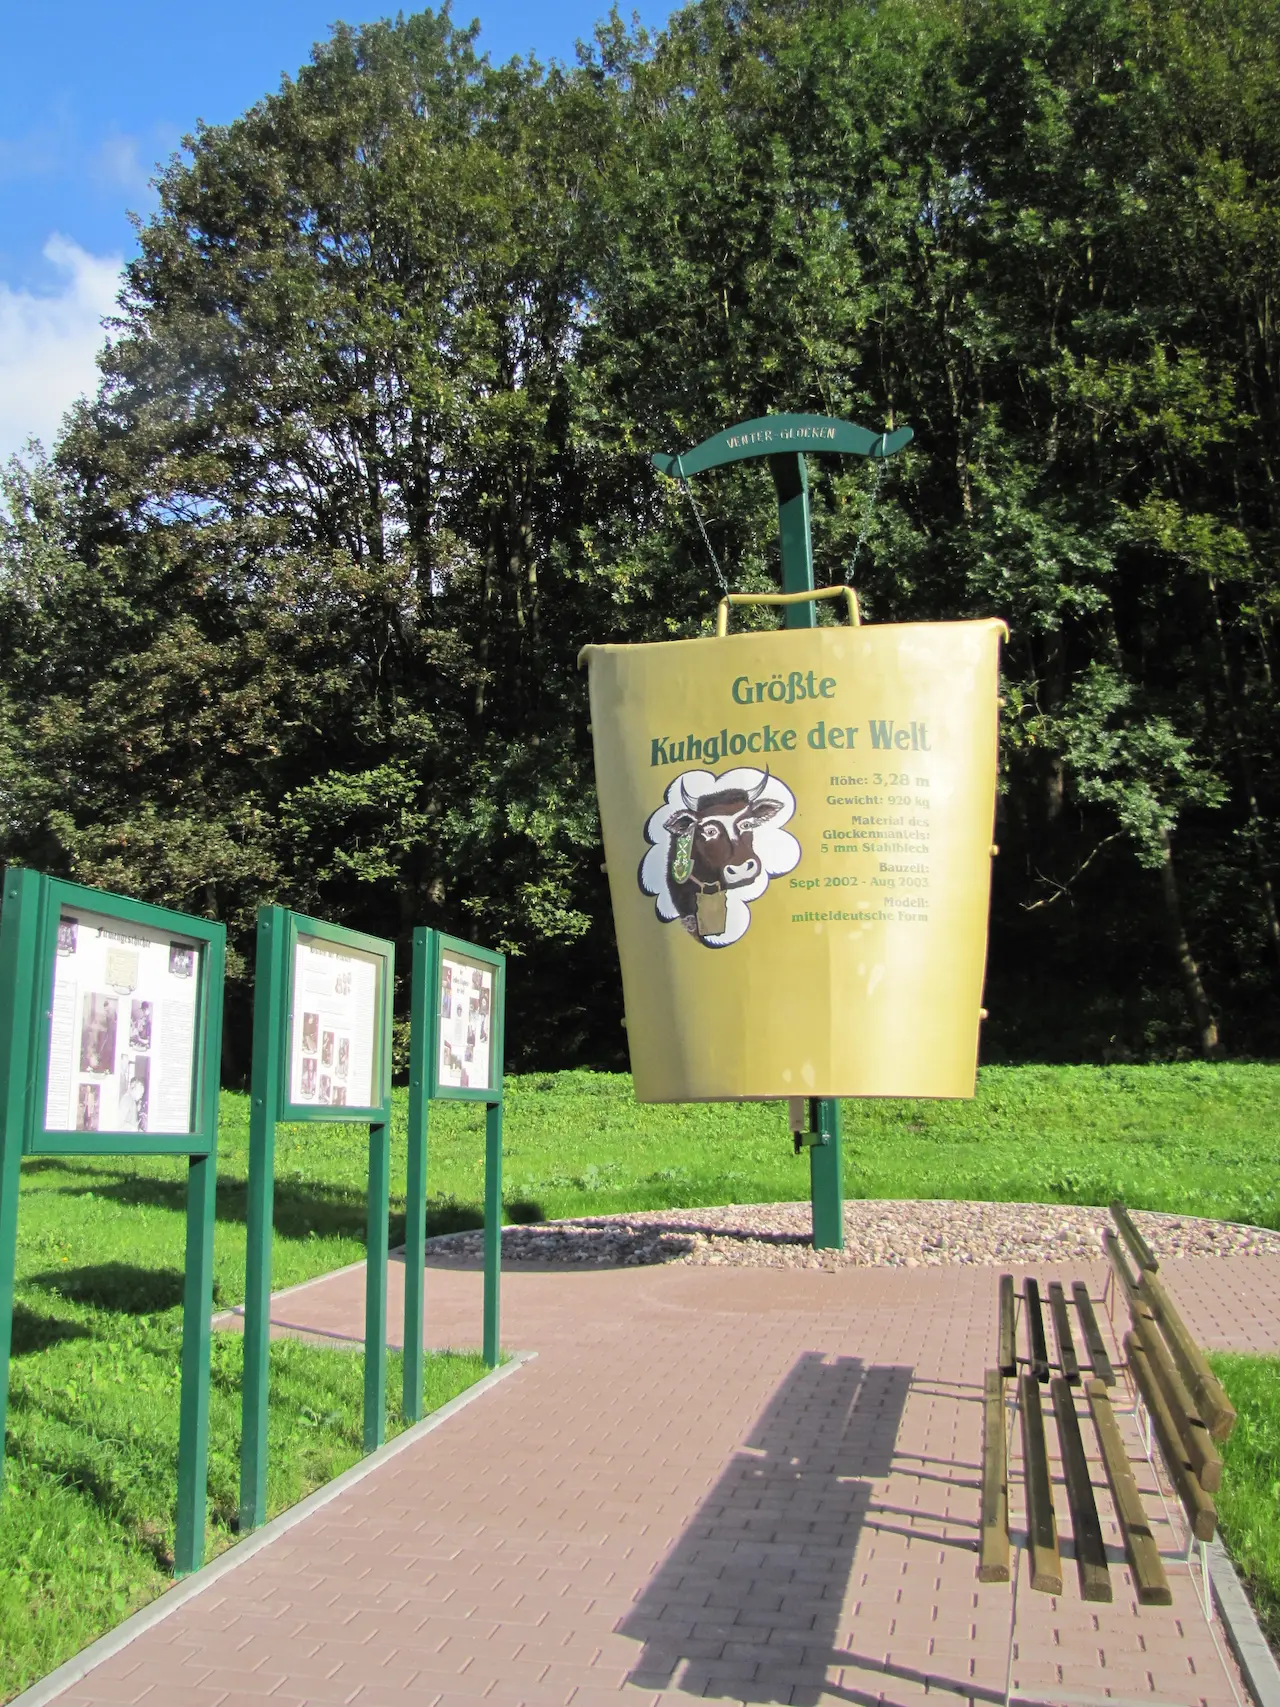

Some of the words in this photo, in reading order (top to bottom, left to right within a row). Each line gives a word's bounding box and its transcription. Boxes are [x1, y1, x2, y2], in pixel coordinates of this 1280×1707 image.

[731, 670, 837, 705] Größte
[650, 725, 797, 766] Kuhglocke
[807, 721, 859, 750] der
[868, 719, 932, 751] Welt
[829, 776, 868, 786] Höhe:
[872, 773, 910, 787] 3,28
[915, 777, 930, 787] m
[826, 795, 883, 805] Gewicht:
[887, 796, 912, 805] 920
[914, 797, 930, 808] kg
[851, 815, 904, 826] Material
[908, 816, 930, 827] des
[822, 829, 931, 840] Glockenmantels:
[820, 843, 829, 853] 5
[834, 845, 858, 853] mm
[862, 843, 929, 853] Stahlblech
[879, 862, 930, 873] Bauzeit:
[789, 878, 820, 889] Sept
[823, 877, 858, 887] 2002
[870, 877, 895, 889] Aug
[898, 878, 929, 888] 2003
[883, 896, 930, 908] Modell:
[791, 911, 894, 922] mitteldeutsche
[897, 911, 928, 922] Form
